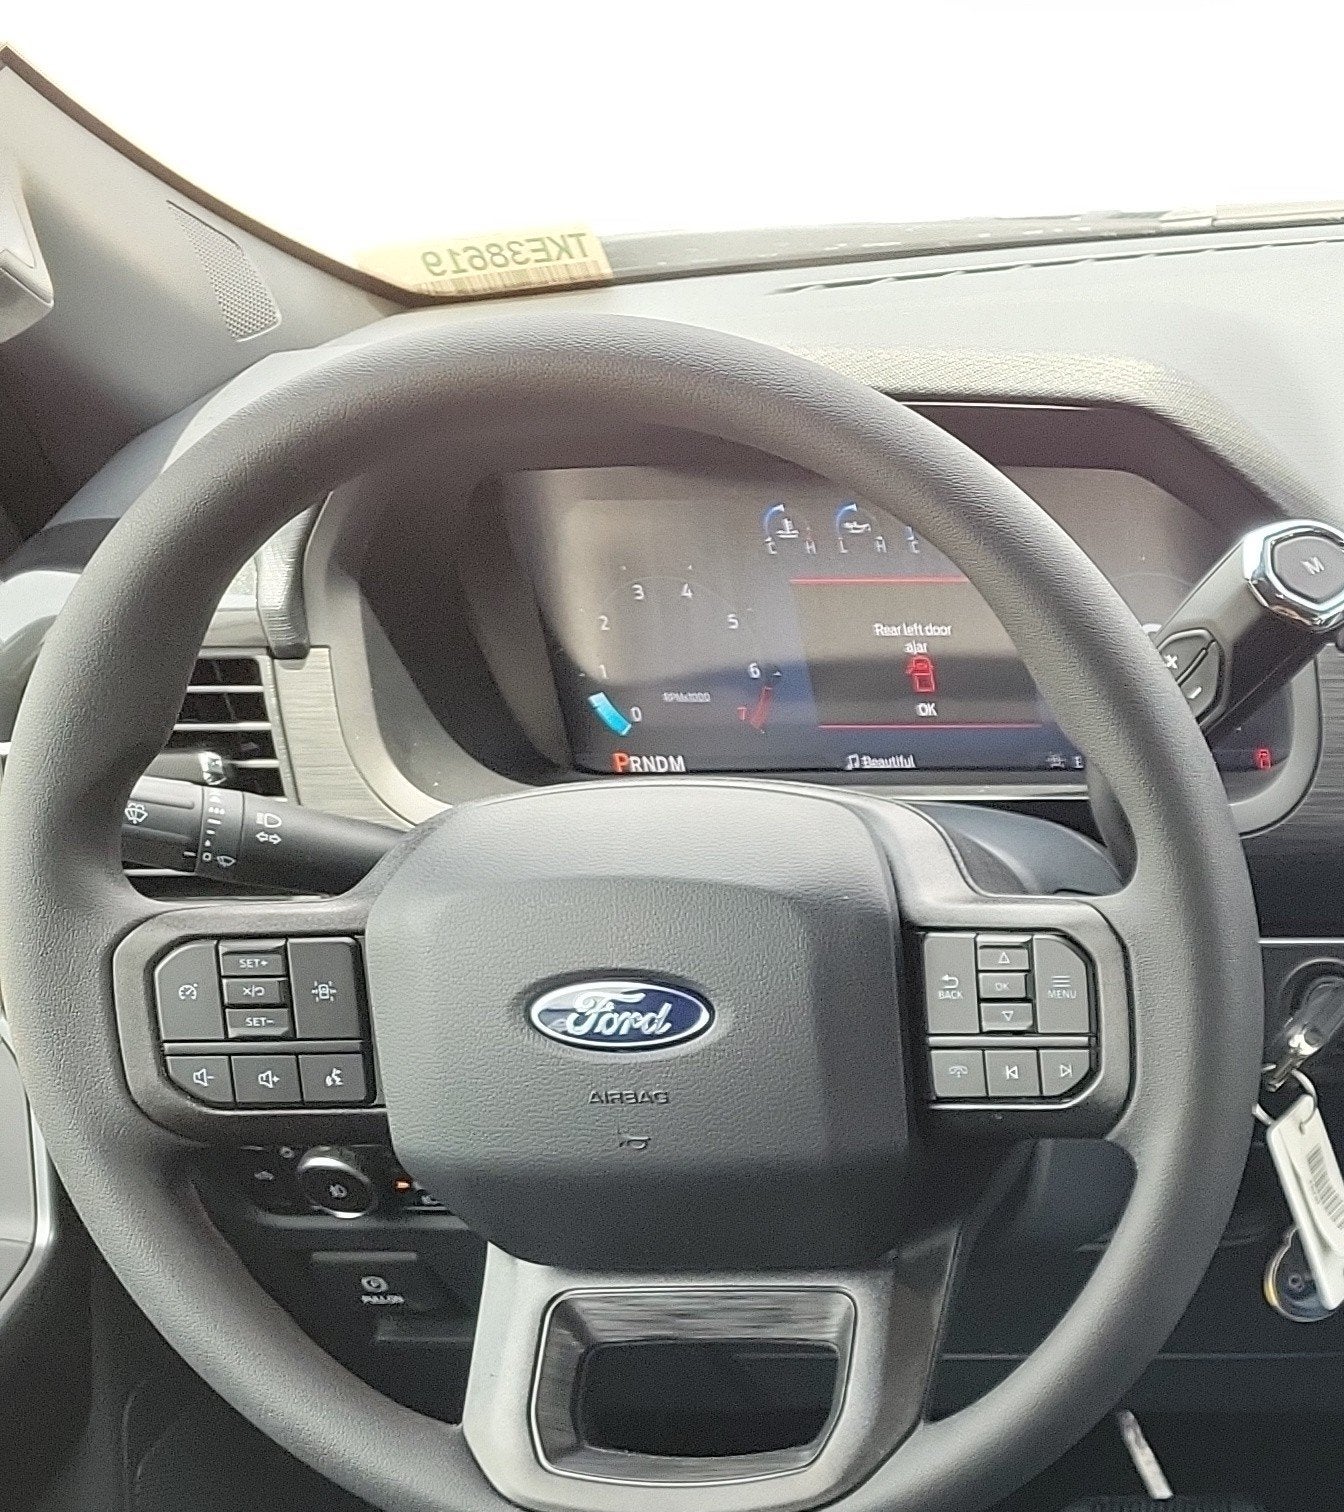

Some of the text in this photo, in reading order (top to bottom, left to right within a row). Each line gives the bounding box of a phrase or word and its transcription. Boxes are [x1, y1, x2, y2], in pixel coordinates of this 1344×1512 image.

[1302, 556, 1325, 576] M
[631, 584, 645, 600] 3
[681, 584, 693, 599] 4
[600, 616, 611, 631] 2
[727, 614, 739, 629] 5
[874, 623, 953, 636] Rear left door
[905, 641, 928, 655] ajar
[750, 664, 761, 679] 6
[630, 707, 642, 722] 0
[916, 703, 938, 717] OK
[861, 754, 917, 770] Beautiful
[938, 990, 964, 1000] BACK
[1048, 990, 1077, 999] MENU
[564, 991, 673, 1036] Ford
[588, 1091, 671, 1105] AIRBAG
